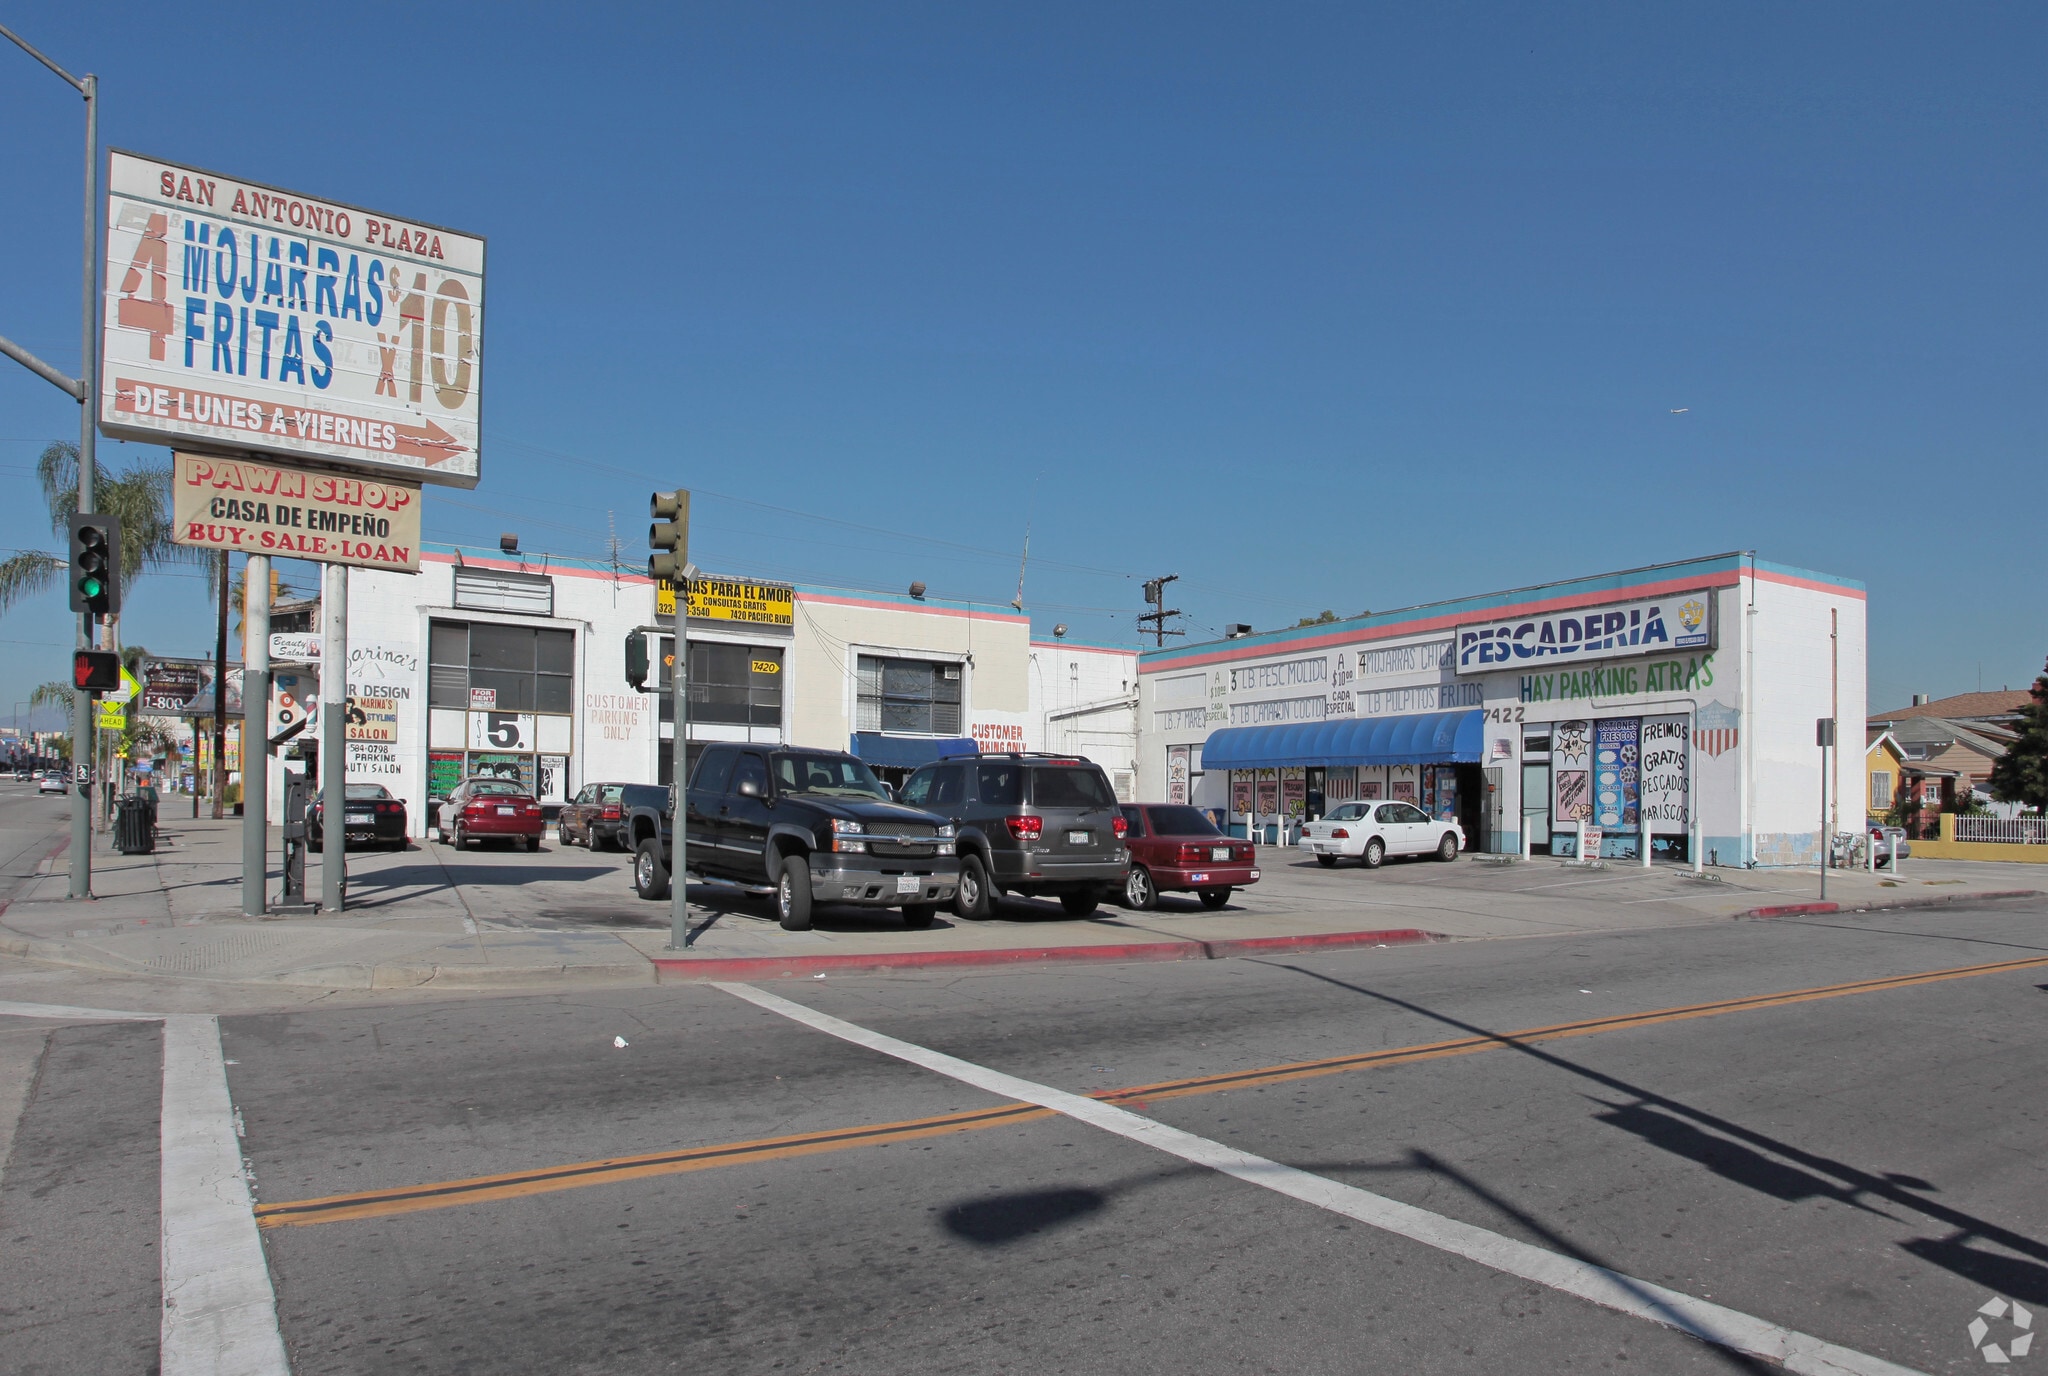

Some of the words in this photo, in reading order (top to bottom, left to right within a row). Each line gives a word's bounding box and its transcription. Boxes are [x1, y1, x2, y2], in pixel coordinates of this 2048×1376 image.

[160, 171, 215, 207] SAN
[231, 188, 351, 239] ANTONIO
[366, 218, 444, 260] PLAZA
[183, 219, 385, 328] MOJARRAS
[118, 213, 174, 362] 4
[185, 296, 334, 390] FRITAS
[134, 384, 169, 416] DE
[178, 391, 263, 431] LUNES
[269, 406, 287, 436] A
[295, 409, 398, 452] VIERNES
[186, 458, 305, 499] PAWN
[312, 475, 411, 513] SHOP
[210, 496, 270, 524] CASA
[276, 504, 302, 528] DE
[308, 511, 390, 539] EMPEÑO
[188, 522, 247, 545] BUY
[260, 530, 328, 555] SALE
[341, 539, 410, 563] LOAN
[711, 585, 742, 598] PARA
[744, 587, 756, 600] EL
[758, 587, 792, 603] AMOR
[703, 597, 742, 610] CONSULTAS
[743, 601, 767, 612] GRATIS
[730, 609, 747, 621] 7420
[747, 611, 774, 624] PACIFIC
[774, 614, 793, 625] BLVD.
[273, 636, 308, 650] Beauty
[1461, 606, 1668, 666] PESCADERIA
[279, 646, 305, 657] Salon
[346, 645, 418, 672] arina's
[1359, 654, 1366, 673] 4
[1366, 647, 1416, 674] MOJARRAS
[1421, 641, 1456, 670] CHICA
[753, 662, 775, 673] 7420
[1338, 653, 1345, 670] A
[1215, 671, 1220, 684] A
[1231, 670, 1237, 691] 3
[1260, 664, 1285, 688] PESC
[1287, 658, 1328, 685] MOLIDO
[1521, 673, 1554, 704] HAY
[1560, 666, 1638, 700] PARKING
[1645, 654, 1715, 694] ATRAS
[364, 684, 410, 700] DESIGN
[1332, 690, 1350, 701] CADA
[1368, 692, 1380, 714] LB
[1386, 687, 1435, 712] PULPITOS
[1441, 683, 1483, 708] FRITOS
[361, 698, 393, 710] MARINA'S
[586, 693, 649, 712] CUSTOMER
[1211, 702, 1223, 711] CADA
[1241, 704, 1250, 724] LB
[1253, 700, 1290, 724] CAMARON
[1293, 698, 1327, 719] COCIDO
[1326, 701, 1356, 715] ESPECIAL
[100, 717, 122, 726] AHEAD
[366, 712, 397, 723] STYLING
[591, 710, 638, 726] PARKING
[1206, 711, 1228, 721] ESPECIAL
[1483, 706, 1525, 724] 7422
[350, 727, 388, 740] SALON
[603, 726, 632, 741] ONLY
[971, 723, 1023, 740] CUSTOMER
[1597, 720, 1639, 732] OSTIONES
[1643, 722, 1688, 744] FREIMOS
[1600, 731, 1637, 742] FRESCOS
[355, 753, 397, 763] PARKING
[1643, 749, 1687, 772] GRATIS
[371, 764, 402, 775] SALON
[1394, 784, 1411, 793] PULPO
[1642, 774, 1690, 796] PESCADOS
[1641, 803, 1689, 824] MARISCOS
